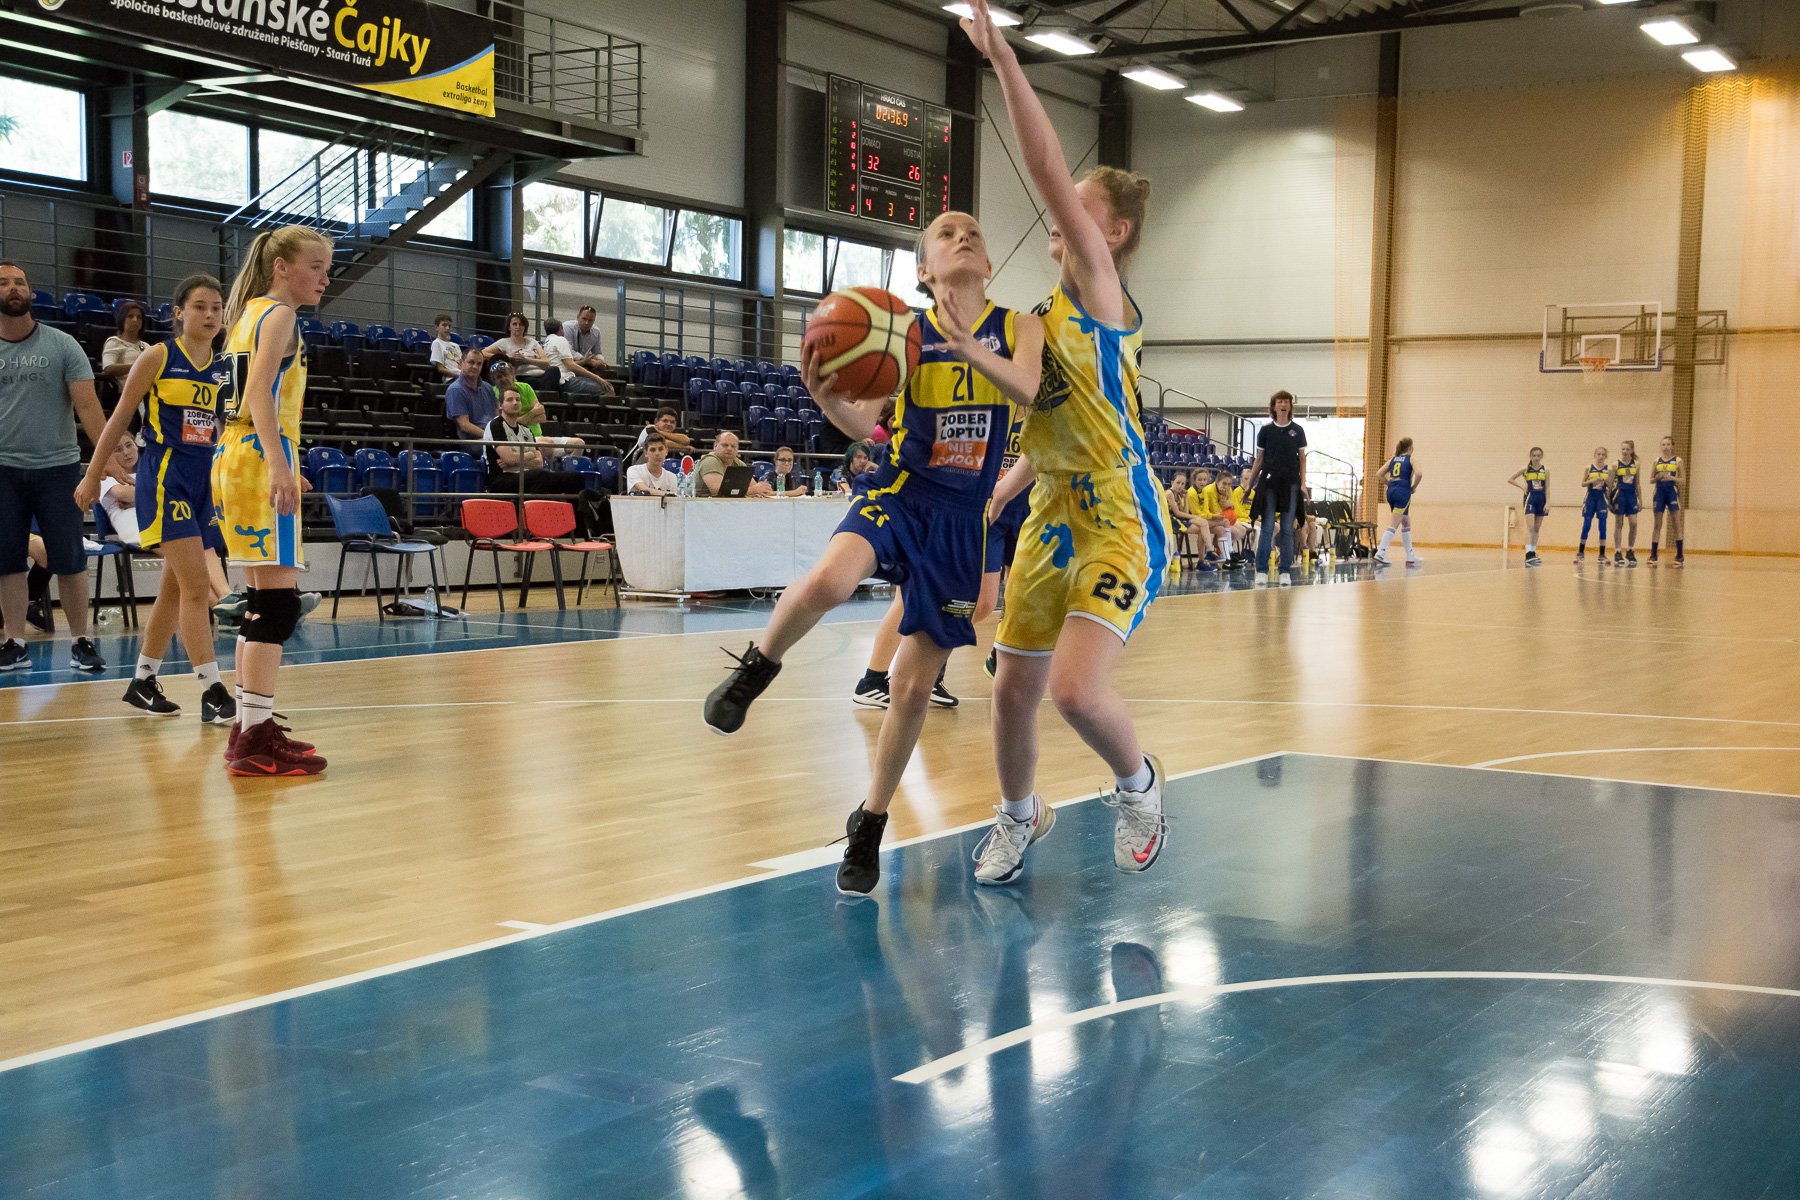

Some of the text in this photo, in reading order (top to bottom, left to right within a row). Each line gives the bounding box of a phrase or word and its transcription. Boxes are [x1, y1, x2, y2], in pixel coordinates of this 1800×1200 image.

[162, 6, 230, 33] basketbalové
[232, 25, 280, 45] združenie
[281, 35, 320, 57] Piešťany
[326, 47, 350, 62] Stará
[352, 52, 371, 67] Turá
[334, 0, 431, 75] Čajky
[456, 81, 488, 96] Basketbal
[443, 90, 472, 105] extraliga
[867, 154, 880, 171] 32
[908, 165, 920, 181] 26
[865, 198, 872, 211] 4
[888, 202, 894, 217] 3
[909, 207, 915, 221] 2
[9, 355, 50, 369] HARD
[952, 365, 974, 402] 21
[192, 383, 212, 407] 20
[940, 426, 986, 440] LOPTU
[948, 442, 974, 453] NIE
[1392, 462, 1402, 477] 8
[168, 500, 192, 522] 20
[1090, 572, 1138, 612] 23
